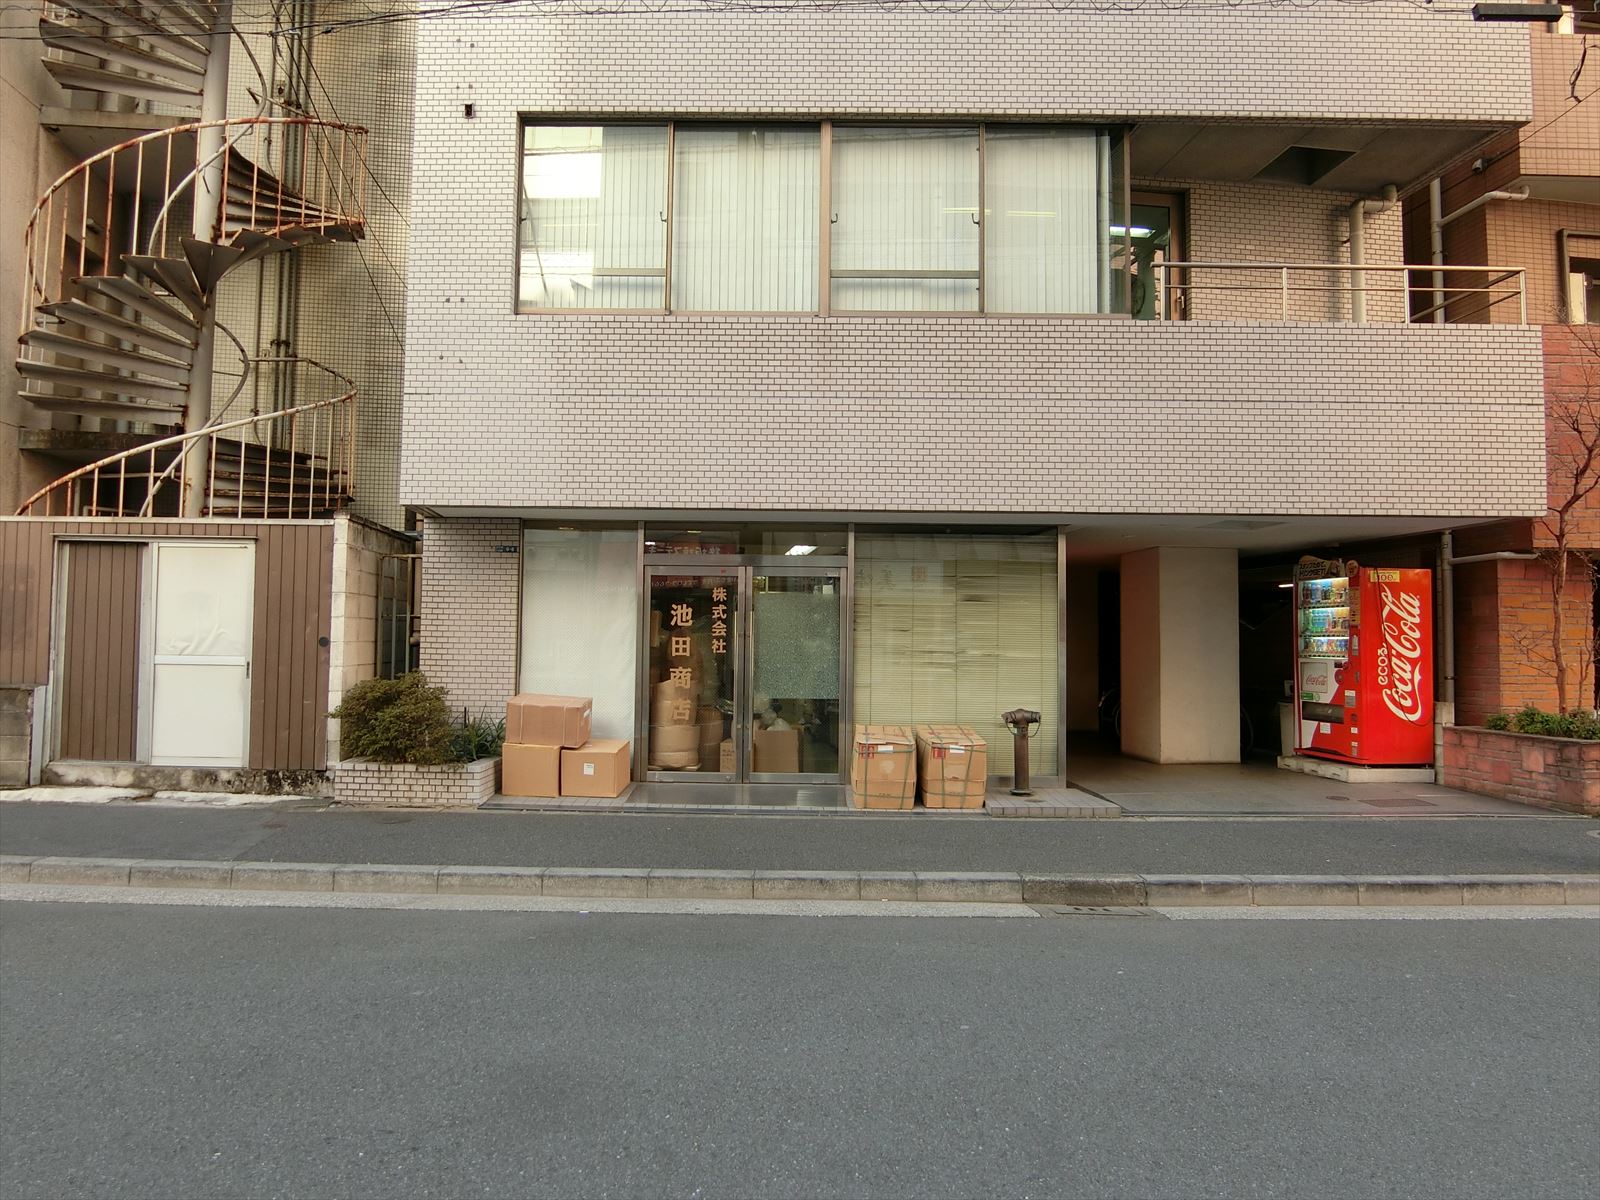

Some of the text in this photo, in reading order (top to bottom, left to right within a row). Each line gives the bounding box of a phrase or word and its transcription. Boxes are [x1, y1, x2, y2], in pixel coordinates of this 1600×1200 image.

[670, 604, 693, 721] 池田商店
[712, 587, 727, 654] 株式会社
